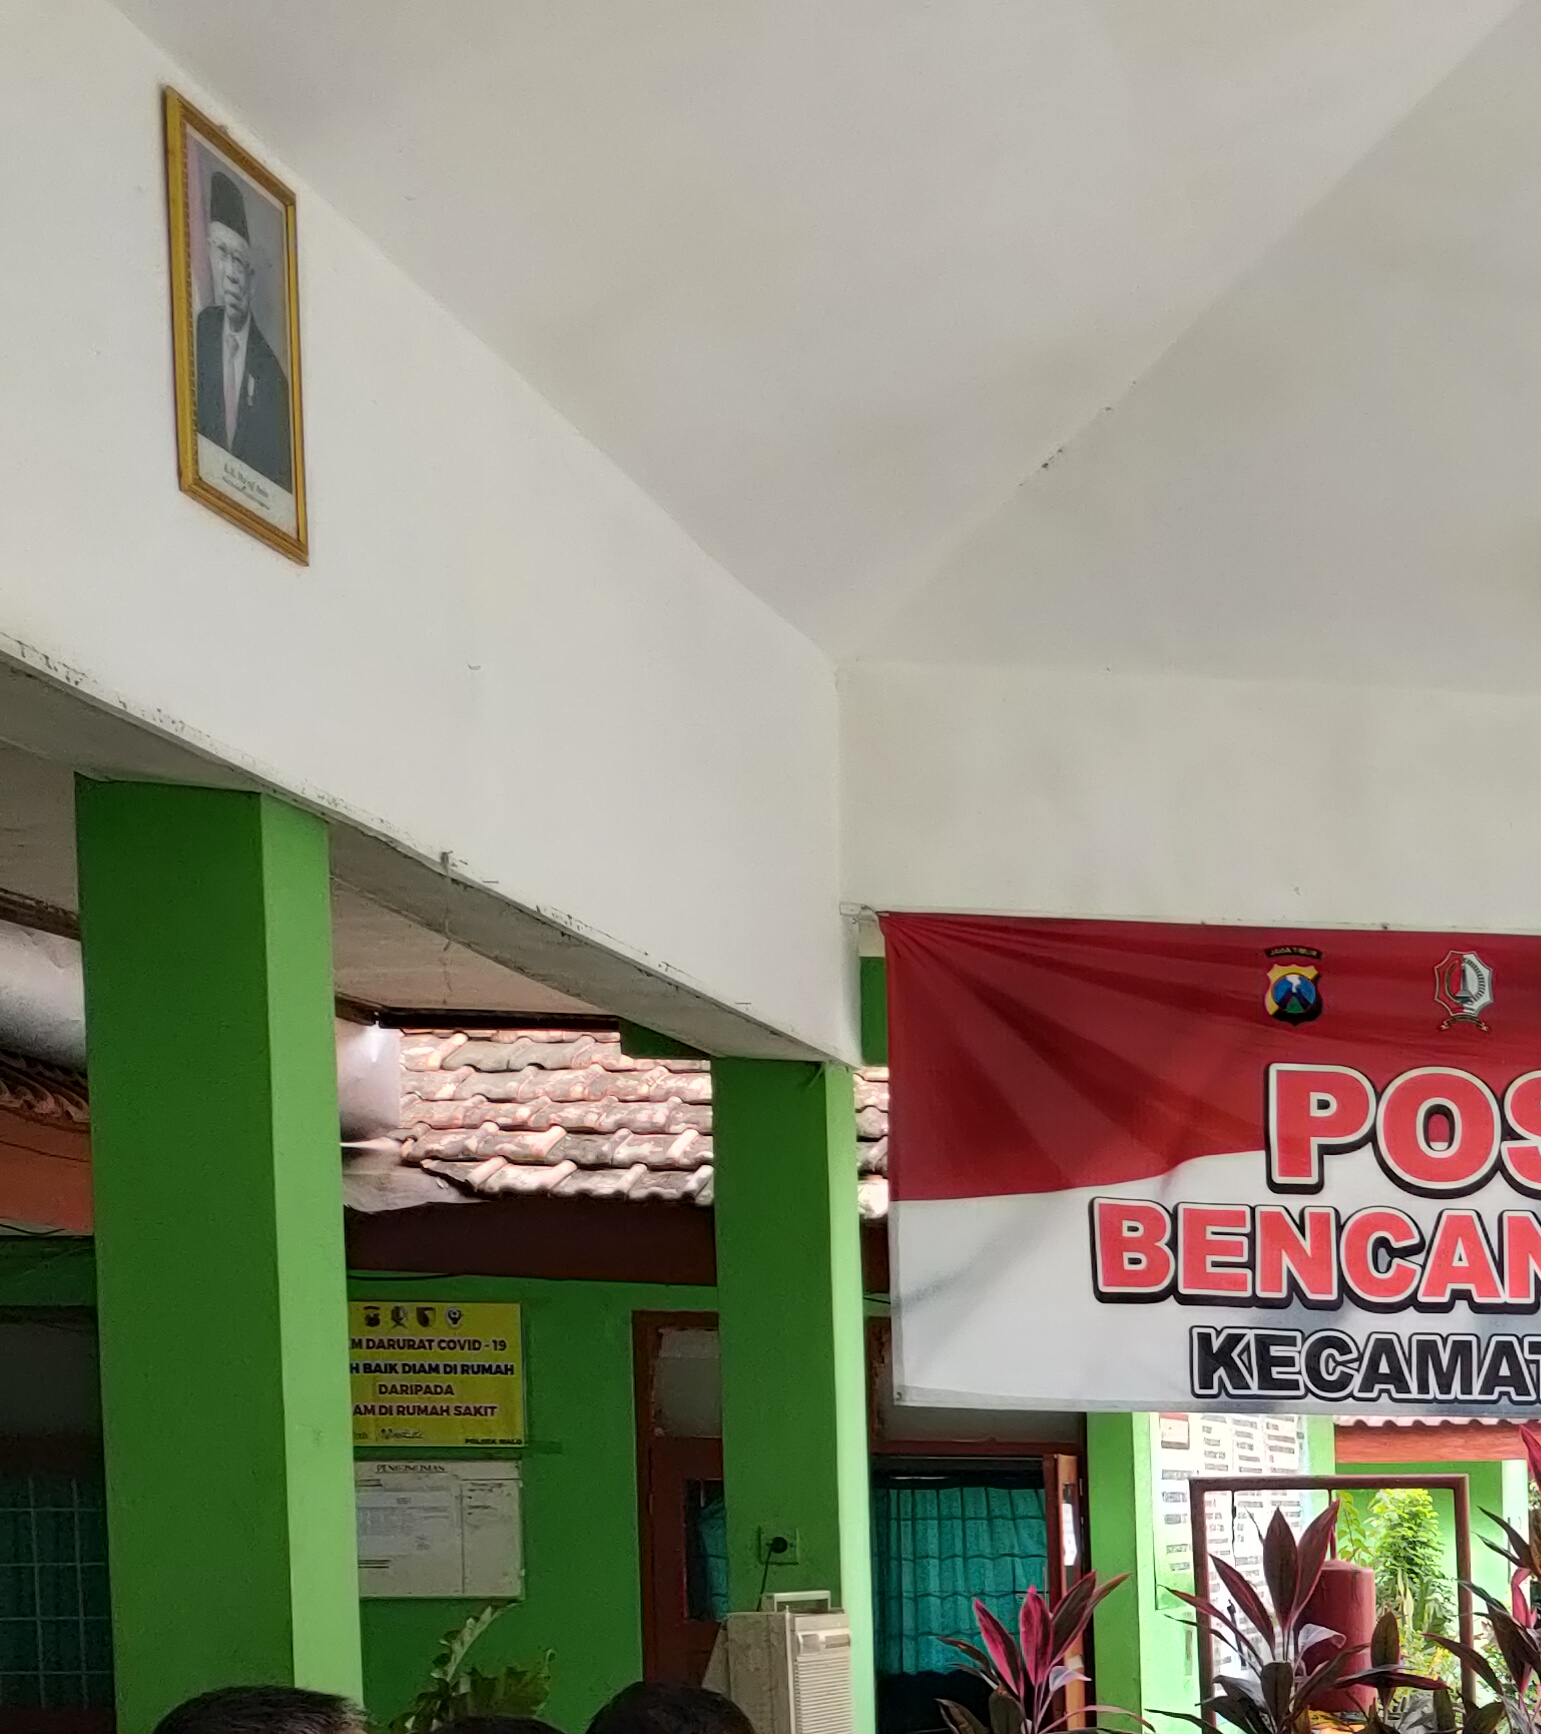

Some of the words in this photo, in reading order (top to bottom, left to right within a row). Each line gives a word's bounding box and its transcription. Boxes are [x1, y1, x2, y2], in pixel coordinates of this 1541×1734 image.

[366, 1338, 435, 1351] DARURAT
[437, 1339, 482, 1351] COVID
[493, 1340, 507, 1351] 19
[363, 1363, 399, 1375] BAIK
[401, 1363, 440, 1375] DIAM
[443, 1364, 458, 1375] DI
[461, 1364, 514, 1376] RUMAH
[378, 1384, 455, 1396] DARIPADA
[378, 1405, 394, 1416] DI
[396, 1405, 450, 1417] RUMAH
[453, 1405, 498, 1417] SAKIT
